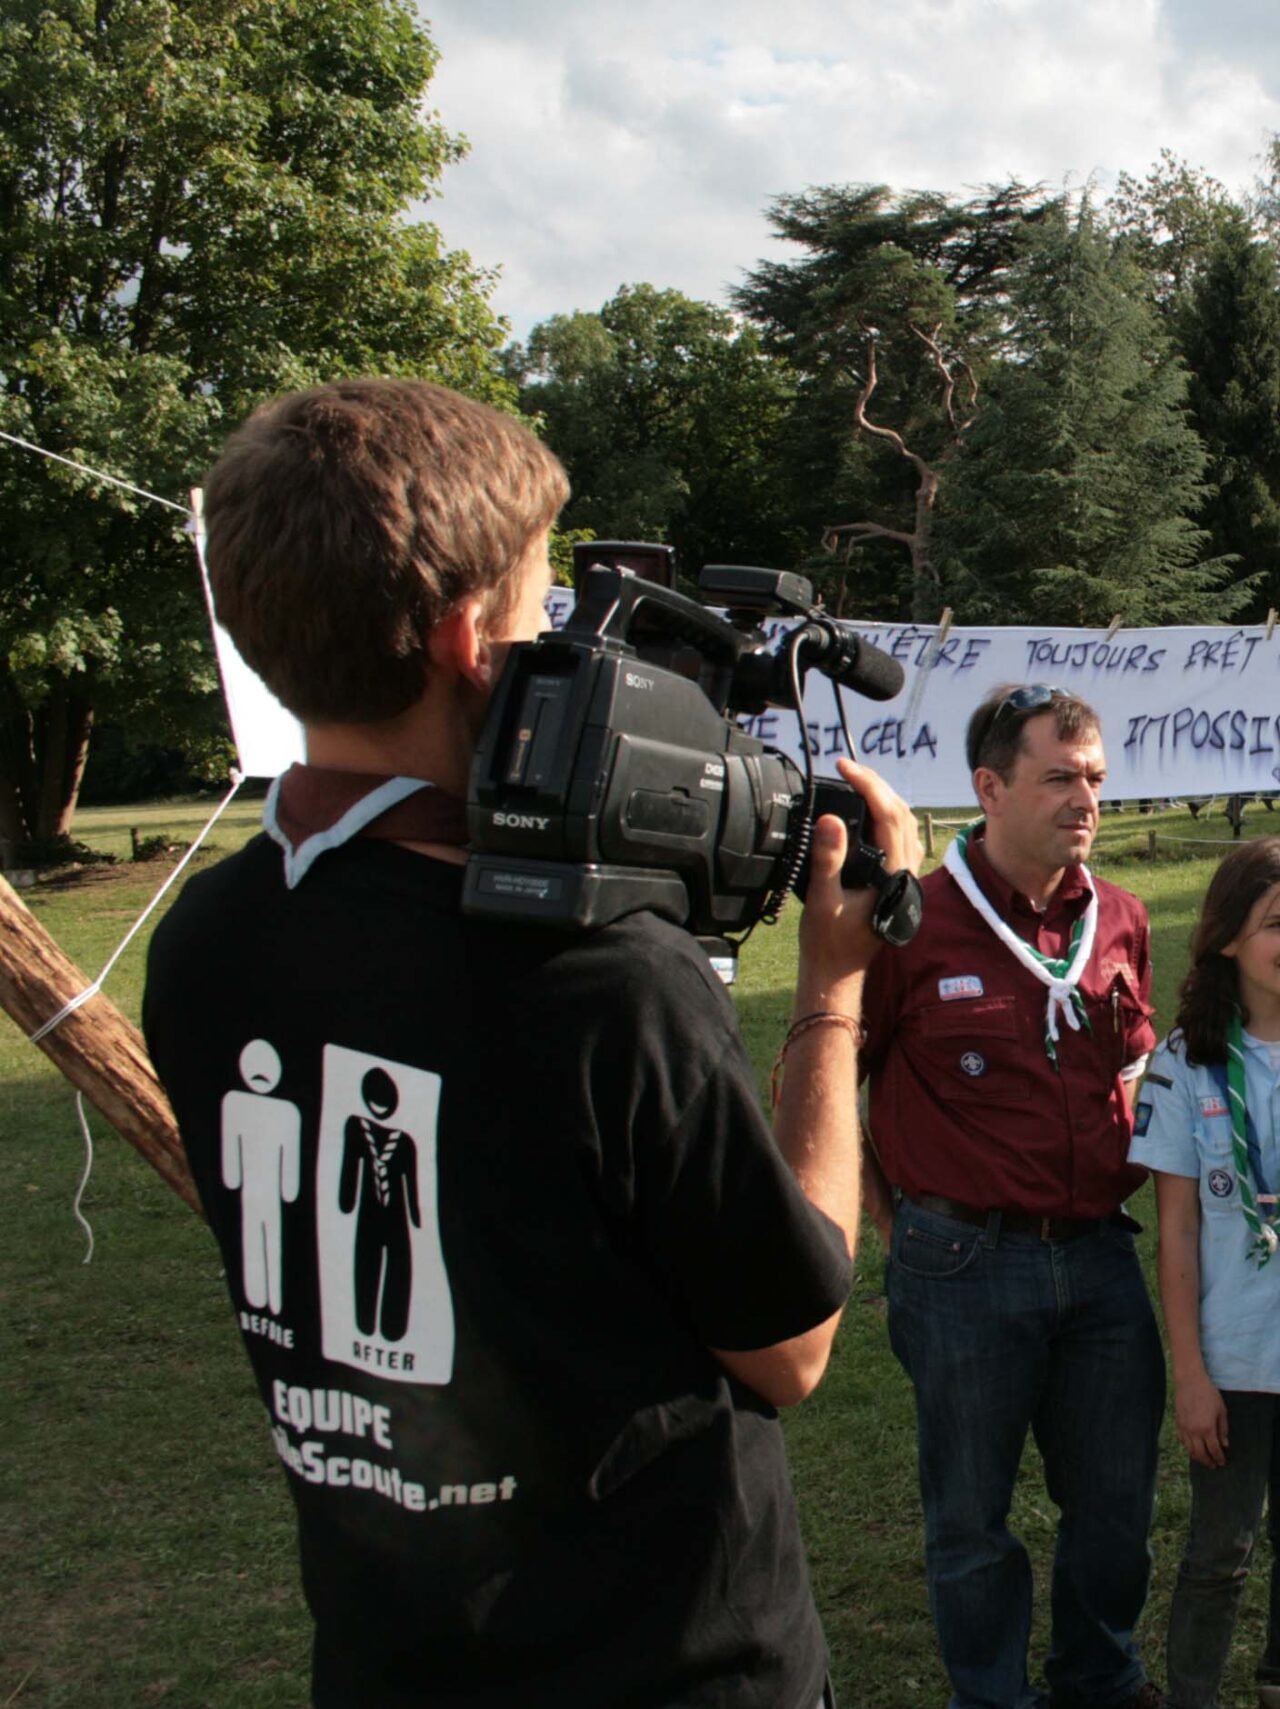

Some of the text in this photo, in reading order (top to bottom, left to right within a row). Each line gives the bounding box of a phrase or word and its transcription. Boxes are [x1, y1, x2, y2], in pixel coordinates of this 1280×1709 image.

[1025, 637, 1166, 672] TOUJOURS
[1183, 630, 1264, 672] PRÊT
[625, 673, 655, 691] SONY
[492, 812, 549, 830] SONY
[352, 1340, 416, 1372] AFTER
[272, 1379, 393, 1450] EQUIPE
